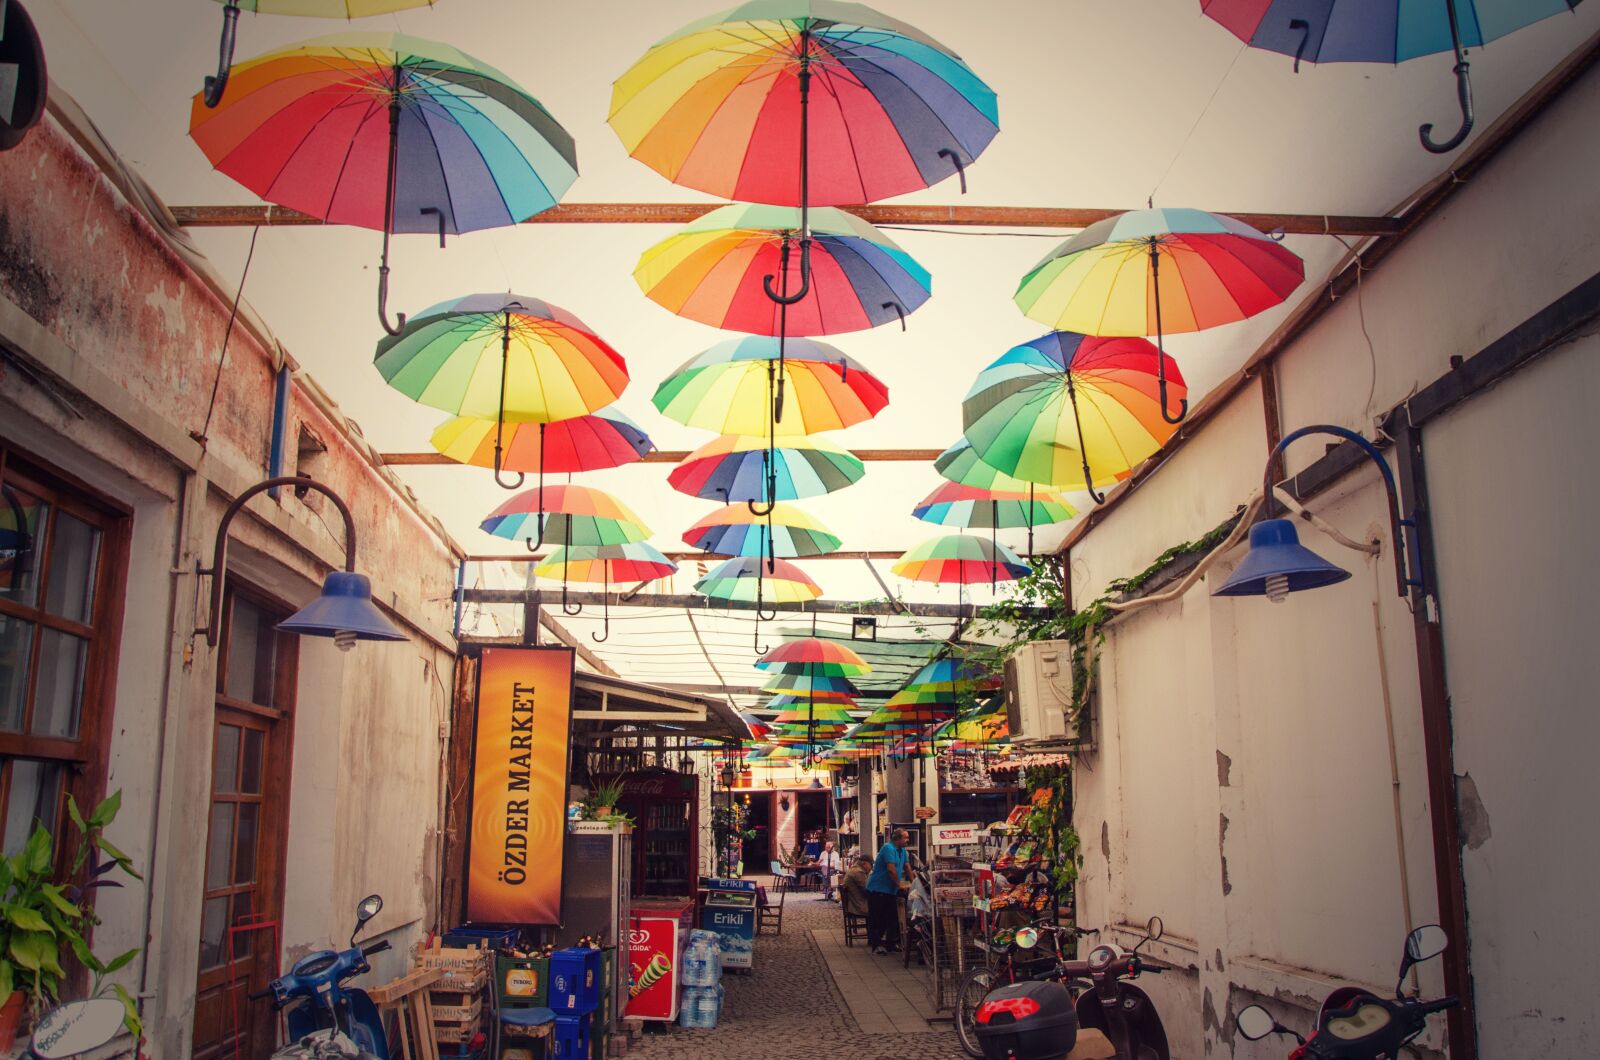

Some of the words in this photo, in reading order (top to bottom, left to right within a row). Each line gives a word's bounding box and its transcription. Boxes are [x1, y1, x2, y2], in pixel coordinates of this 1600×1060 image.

[508, 682, 535, 793] MARKET
[498, 799, 529, 885] ÖZDER
[943, 830, 971, 839] Takvim
[714, 913, 744, 925] Erikli
